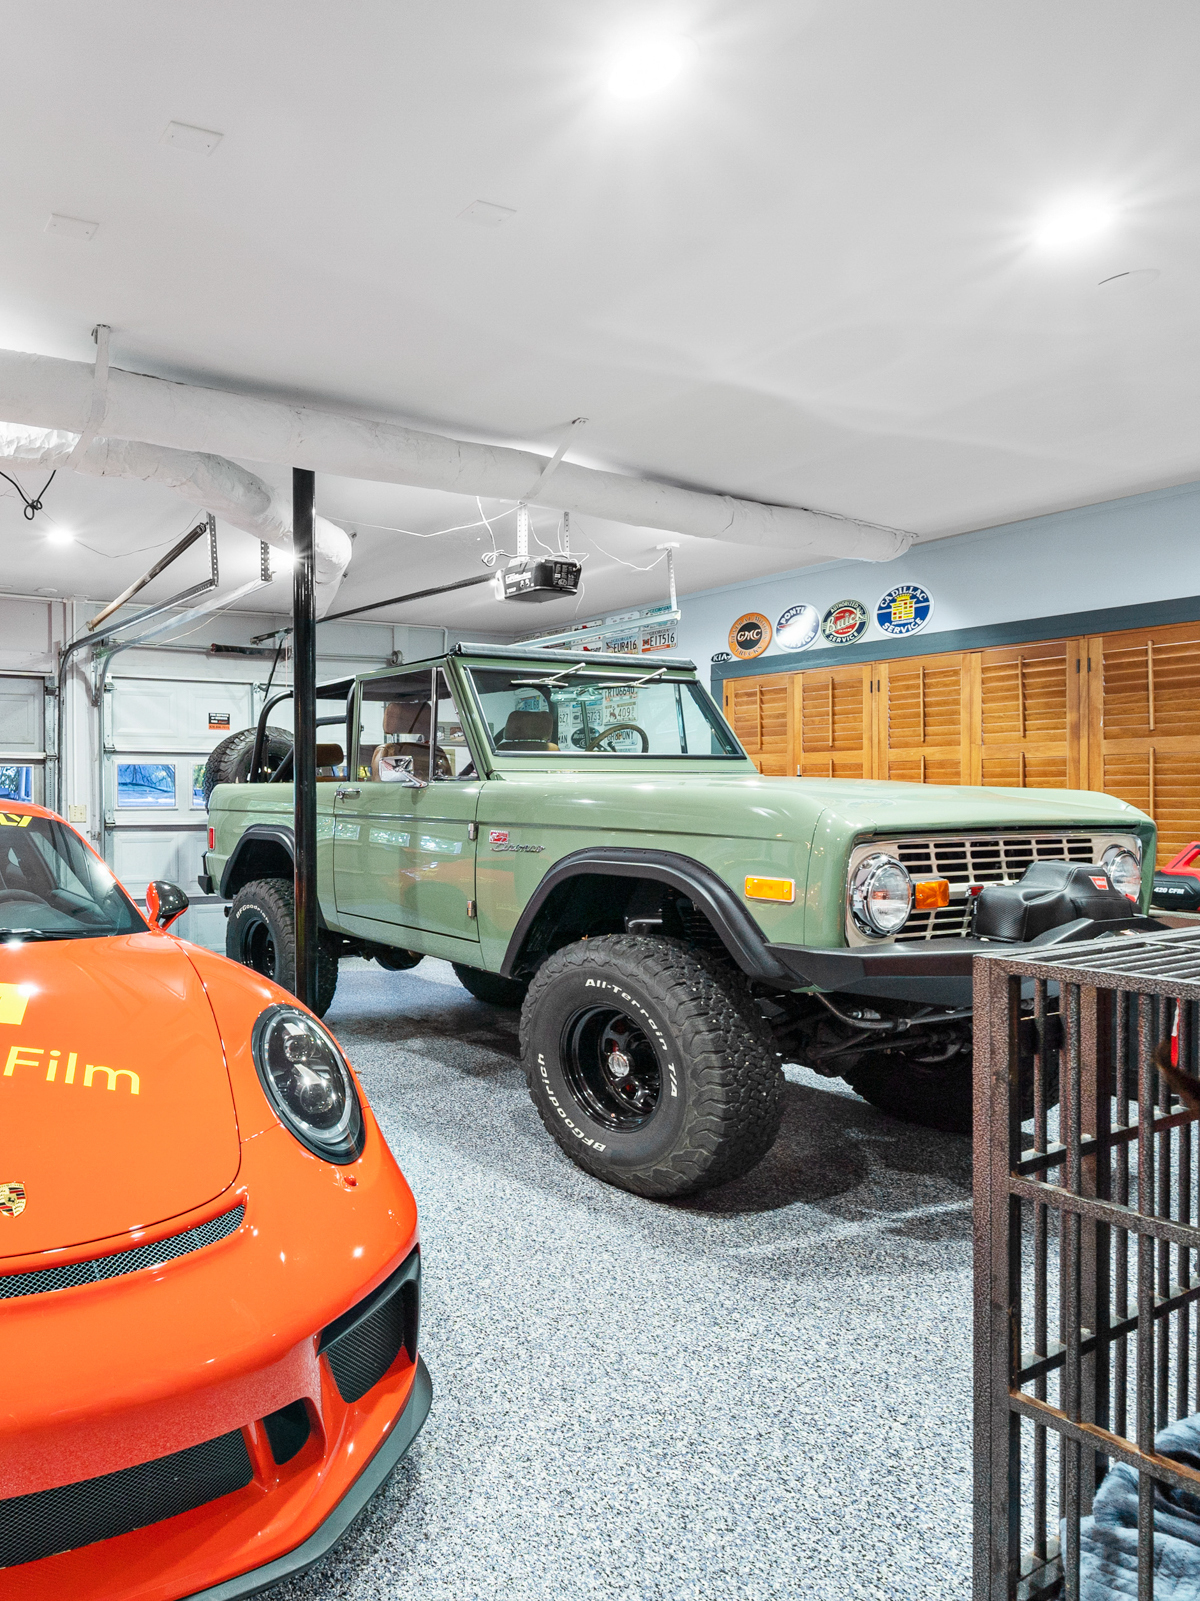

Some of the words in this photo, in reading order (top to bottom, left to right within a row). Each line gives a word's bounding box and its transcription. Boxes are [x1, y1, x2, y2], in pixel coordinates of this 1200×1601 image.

[880, 586, 927, 607] CADILLAC
[780, 606, 806, 624] PONTI
[831, 601, 859, 613] AUTHORIZED
[730, 616, 751, 643] GENERAL
[825, 608, 865, 635] Buick
[882, 617, 924, 634] SERVICE
[737, 629, 761, 641] GMC
[829, 632, 858, 643] SERVICE
[712, 653, 729, 662] KIA
[734, 646, 762, 657] TRUCKS
[618, 705, 631, 719] 409
[584, 977, 668, 1051] All-Terrain
[667, 1062, 679, 1098] T/A
[3, 1045, 140, 1095] Film
[537, 1052, 607, 1153] BFGoodrich
